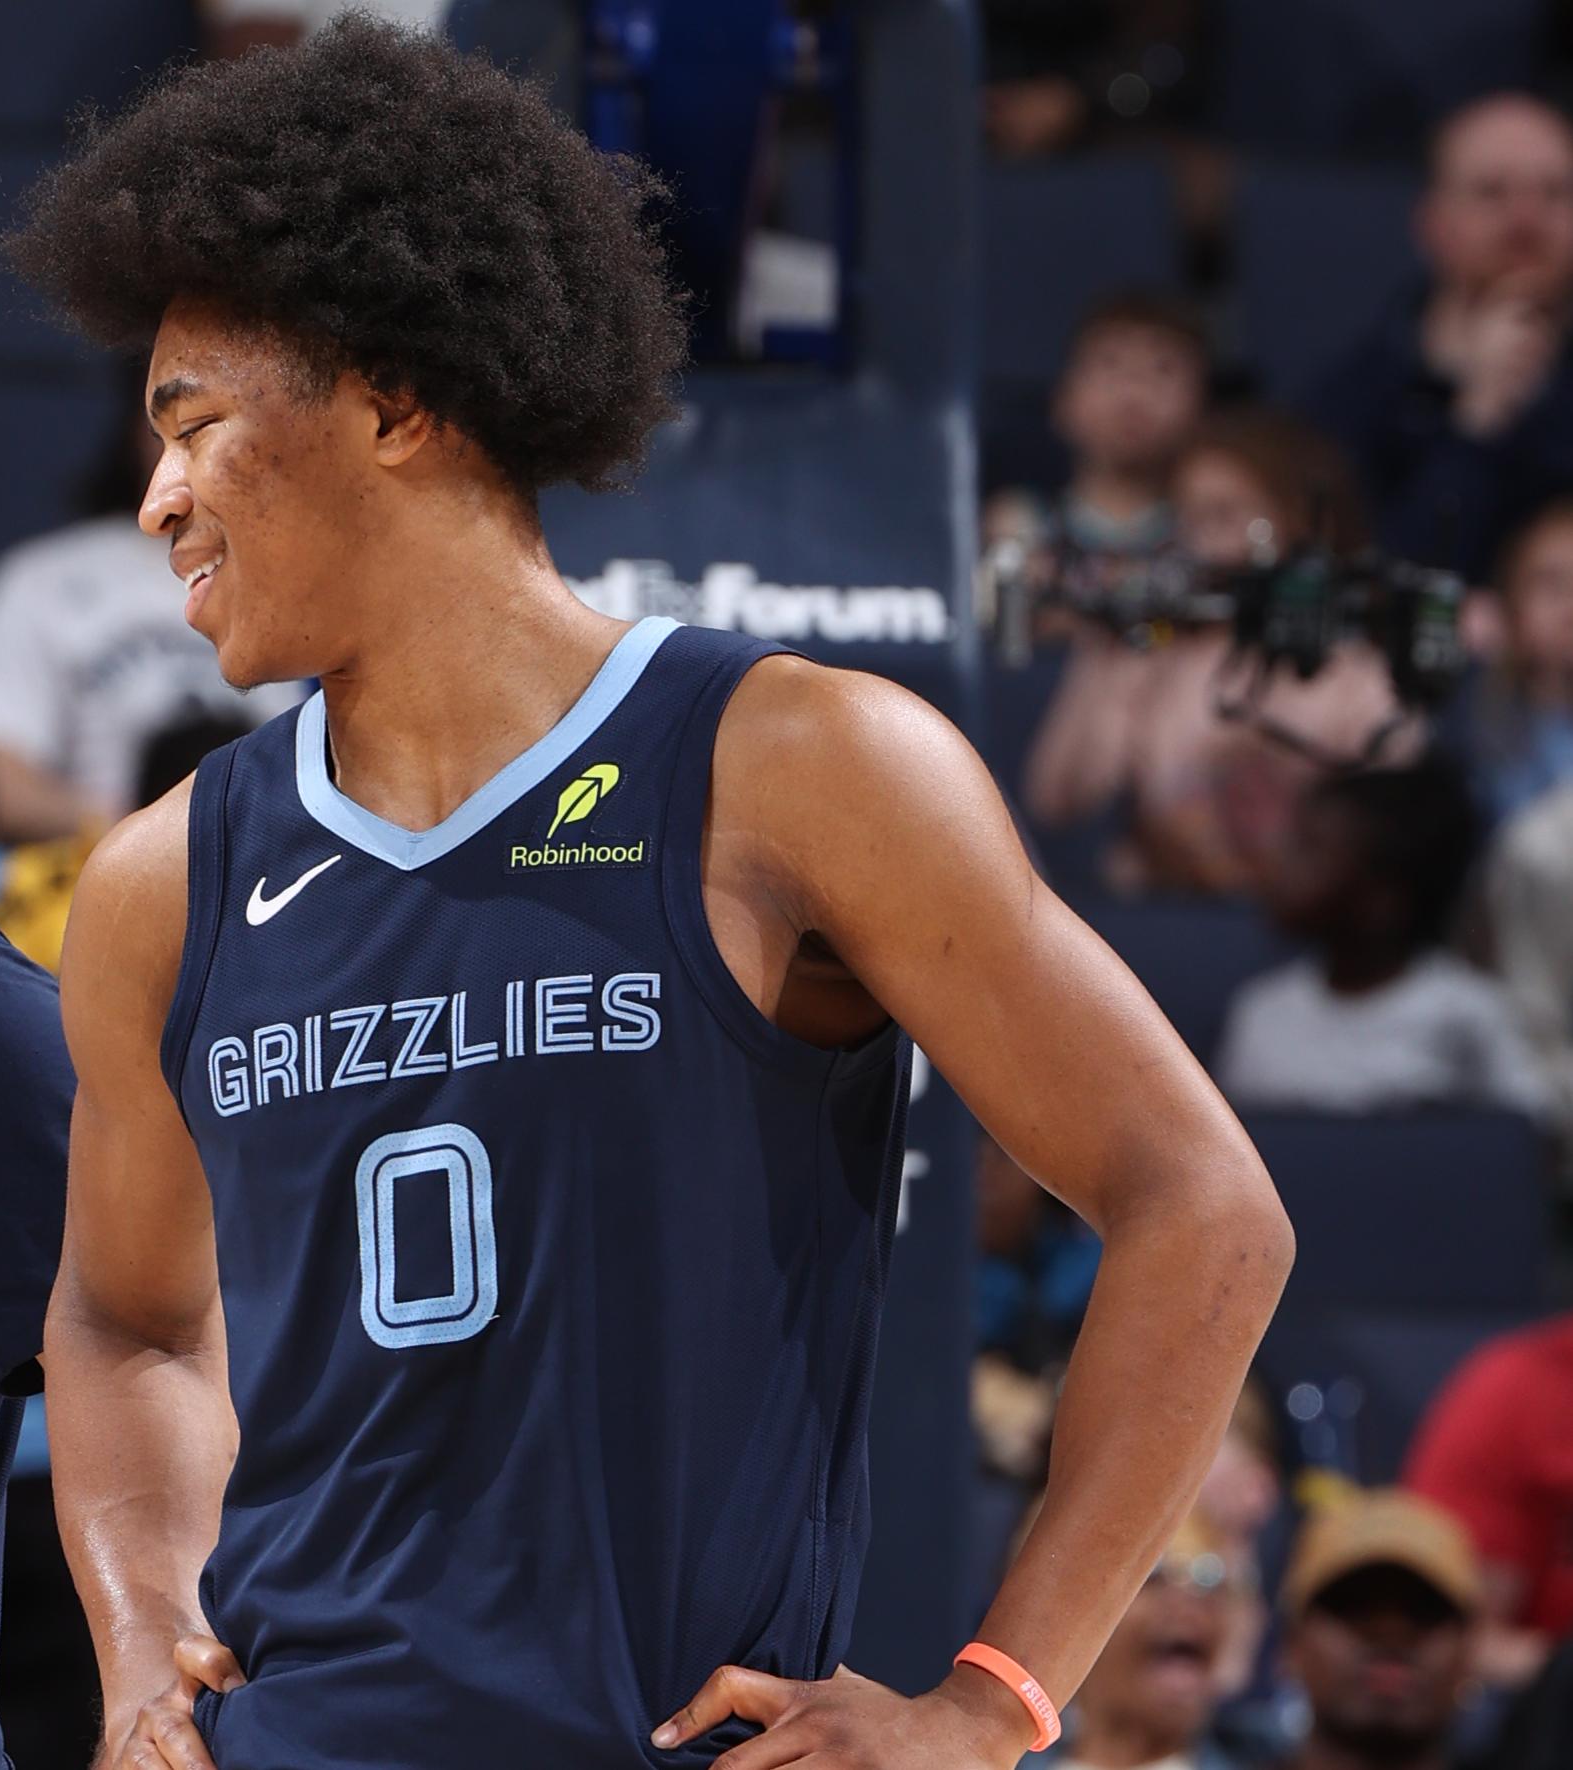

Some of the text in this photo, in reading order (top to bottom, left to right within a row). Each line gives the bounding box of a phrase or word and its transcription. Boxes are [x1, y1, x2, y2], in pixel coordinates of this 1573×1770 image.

[510, 840, 644, 868] Robinhood
[207, 972, 662, 1118] GRIZZLIES
[354, 1122, 498, 1349] 0
